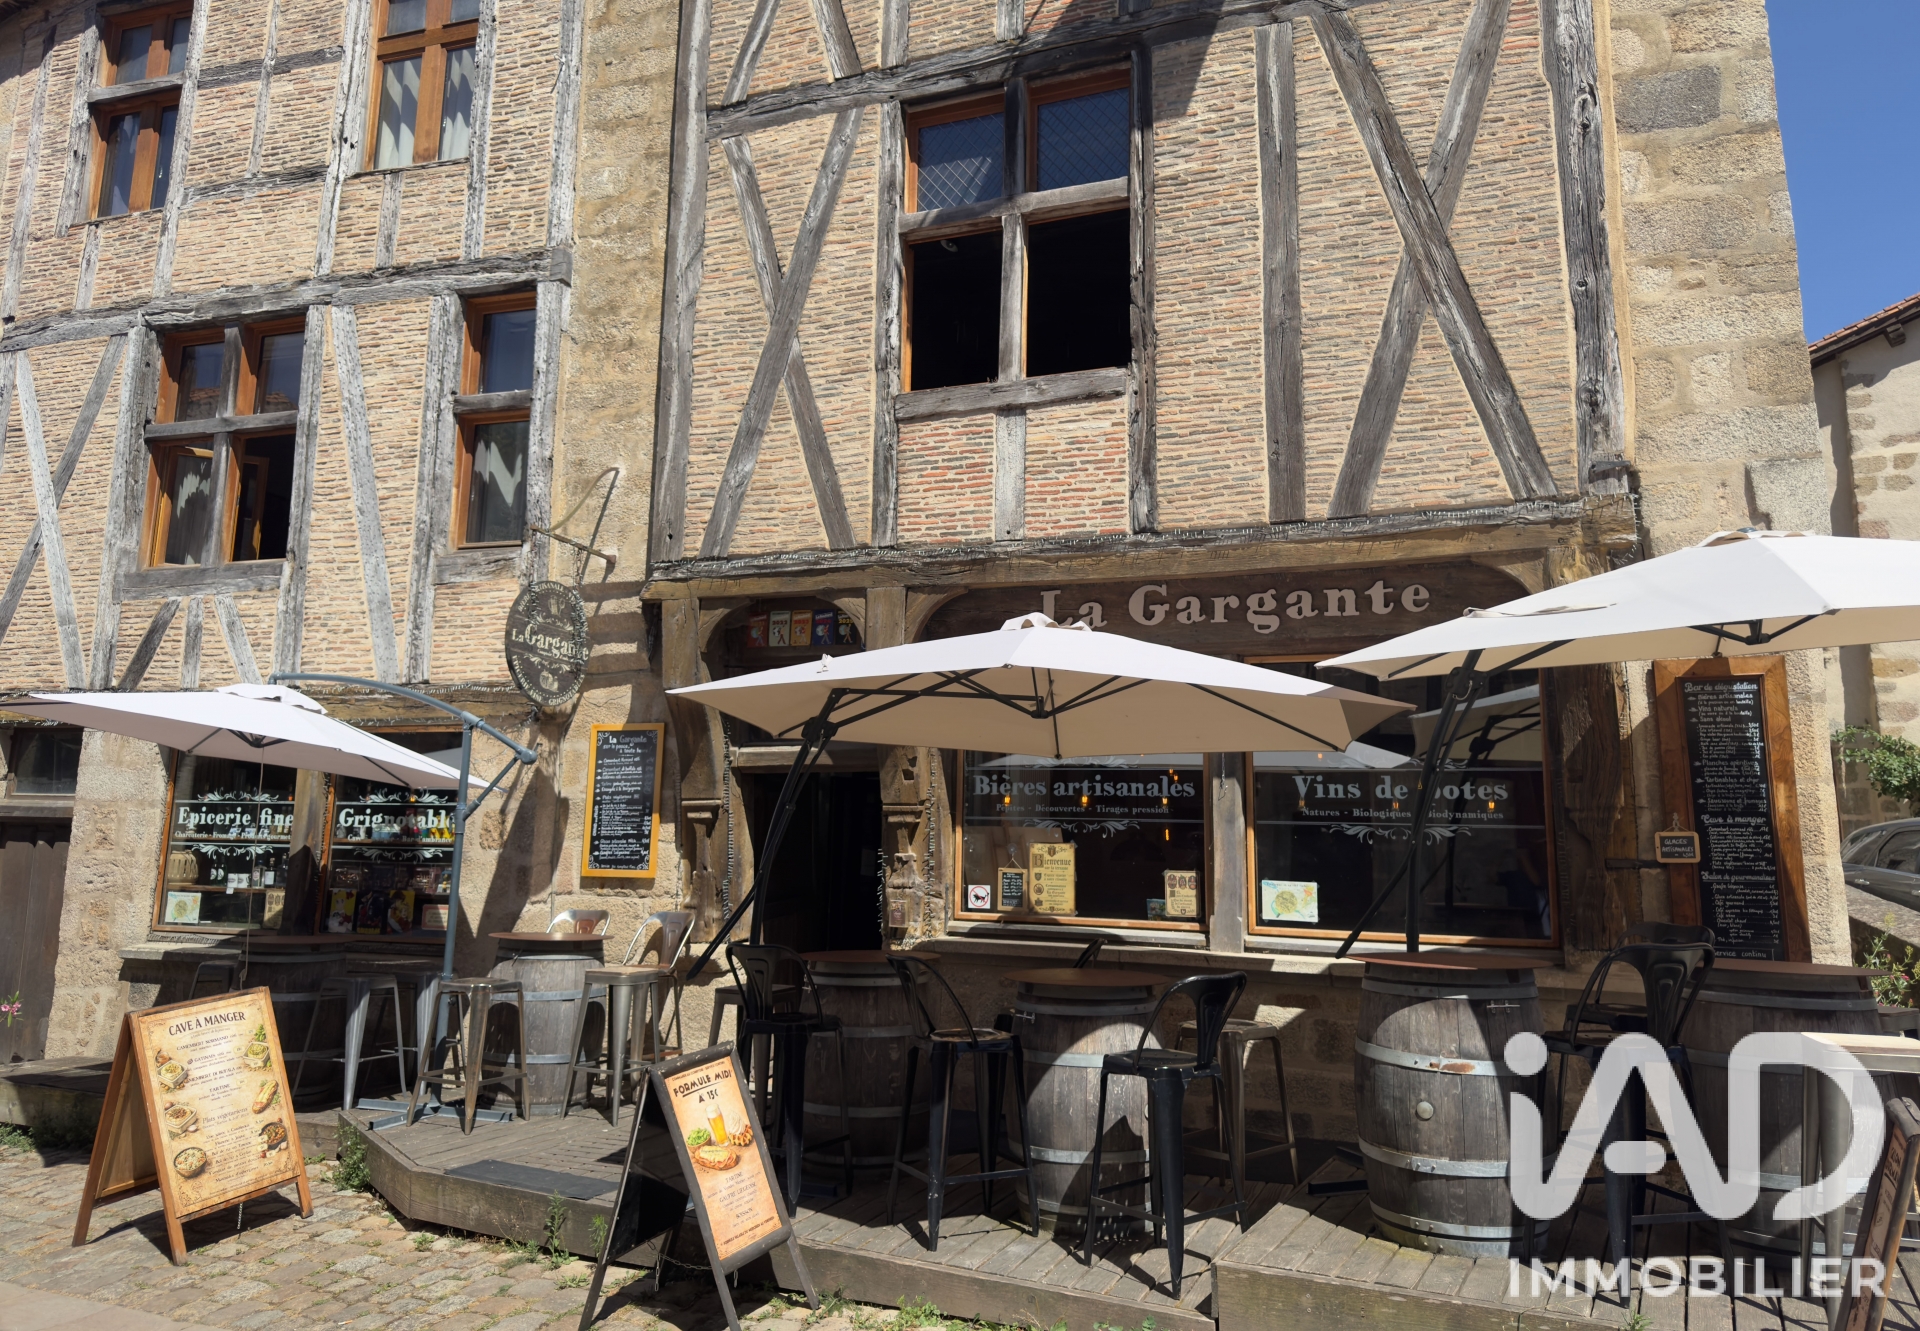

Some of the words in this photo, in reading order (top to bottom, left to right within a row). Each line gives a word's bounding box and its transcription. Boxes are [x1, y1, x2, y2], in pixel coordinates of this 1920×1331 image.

[1041, 590, 1108, 629] La
[1128, 580, 1430, 634] Gargante
[512, 628, 524, 642] La
[1684, 682, 1703, 693] Bar
[1704, 682, 1712, 691] de
[1715, 681, 1759, 692] dégustation
[609, 735, 617, 743] La
[973, 774, 1047, 796] Bières
[1053, 774, 1196, 797] artisanales
[1292, 775, 1361, 799] Vins
[1375, 775, 1409, 799] de
[178, 806, 251, 829] Epicerie
[259, 808, 294, 826] fine
[996, 803, 1025, 813] Pépites
[1035, 803, 1085, 812] Découvertes
[1095, 805, 1129, 814] Tirages
[1132, 805, 1169, 815] pression
[1302, 807, 1340, 817] Natures
[1352, 808, 1412, 819] Biologiques
[339, 808, 451, 828] Grignotabl
[1700, 814, 1724, 823] Cave
[1734, 816, 1767, 826] manger
[1033, 854, 1072, 868] Bienvenue
[168, 1020, 194, 1036] CAVE
[195, 1017, 202, 1029] À
[204, 1011, 246, 1027] MANGER
[673, 1074, 711, 1097] FORMULE
[714, 1069, 732, 1081] MIDI
